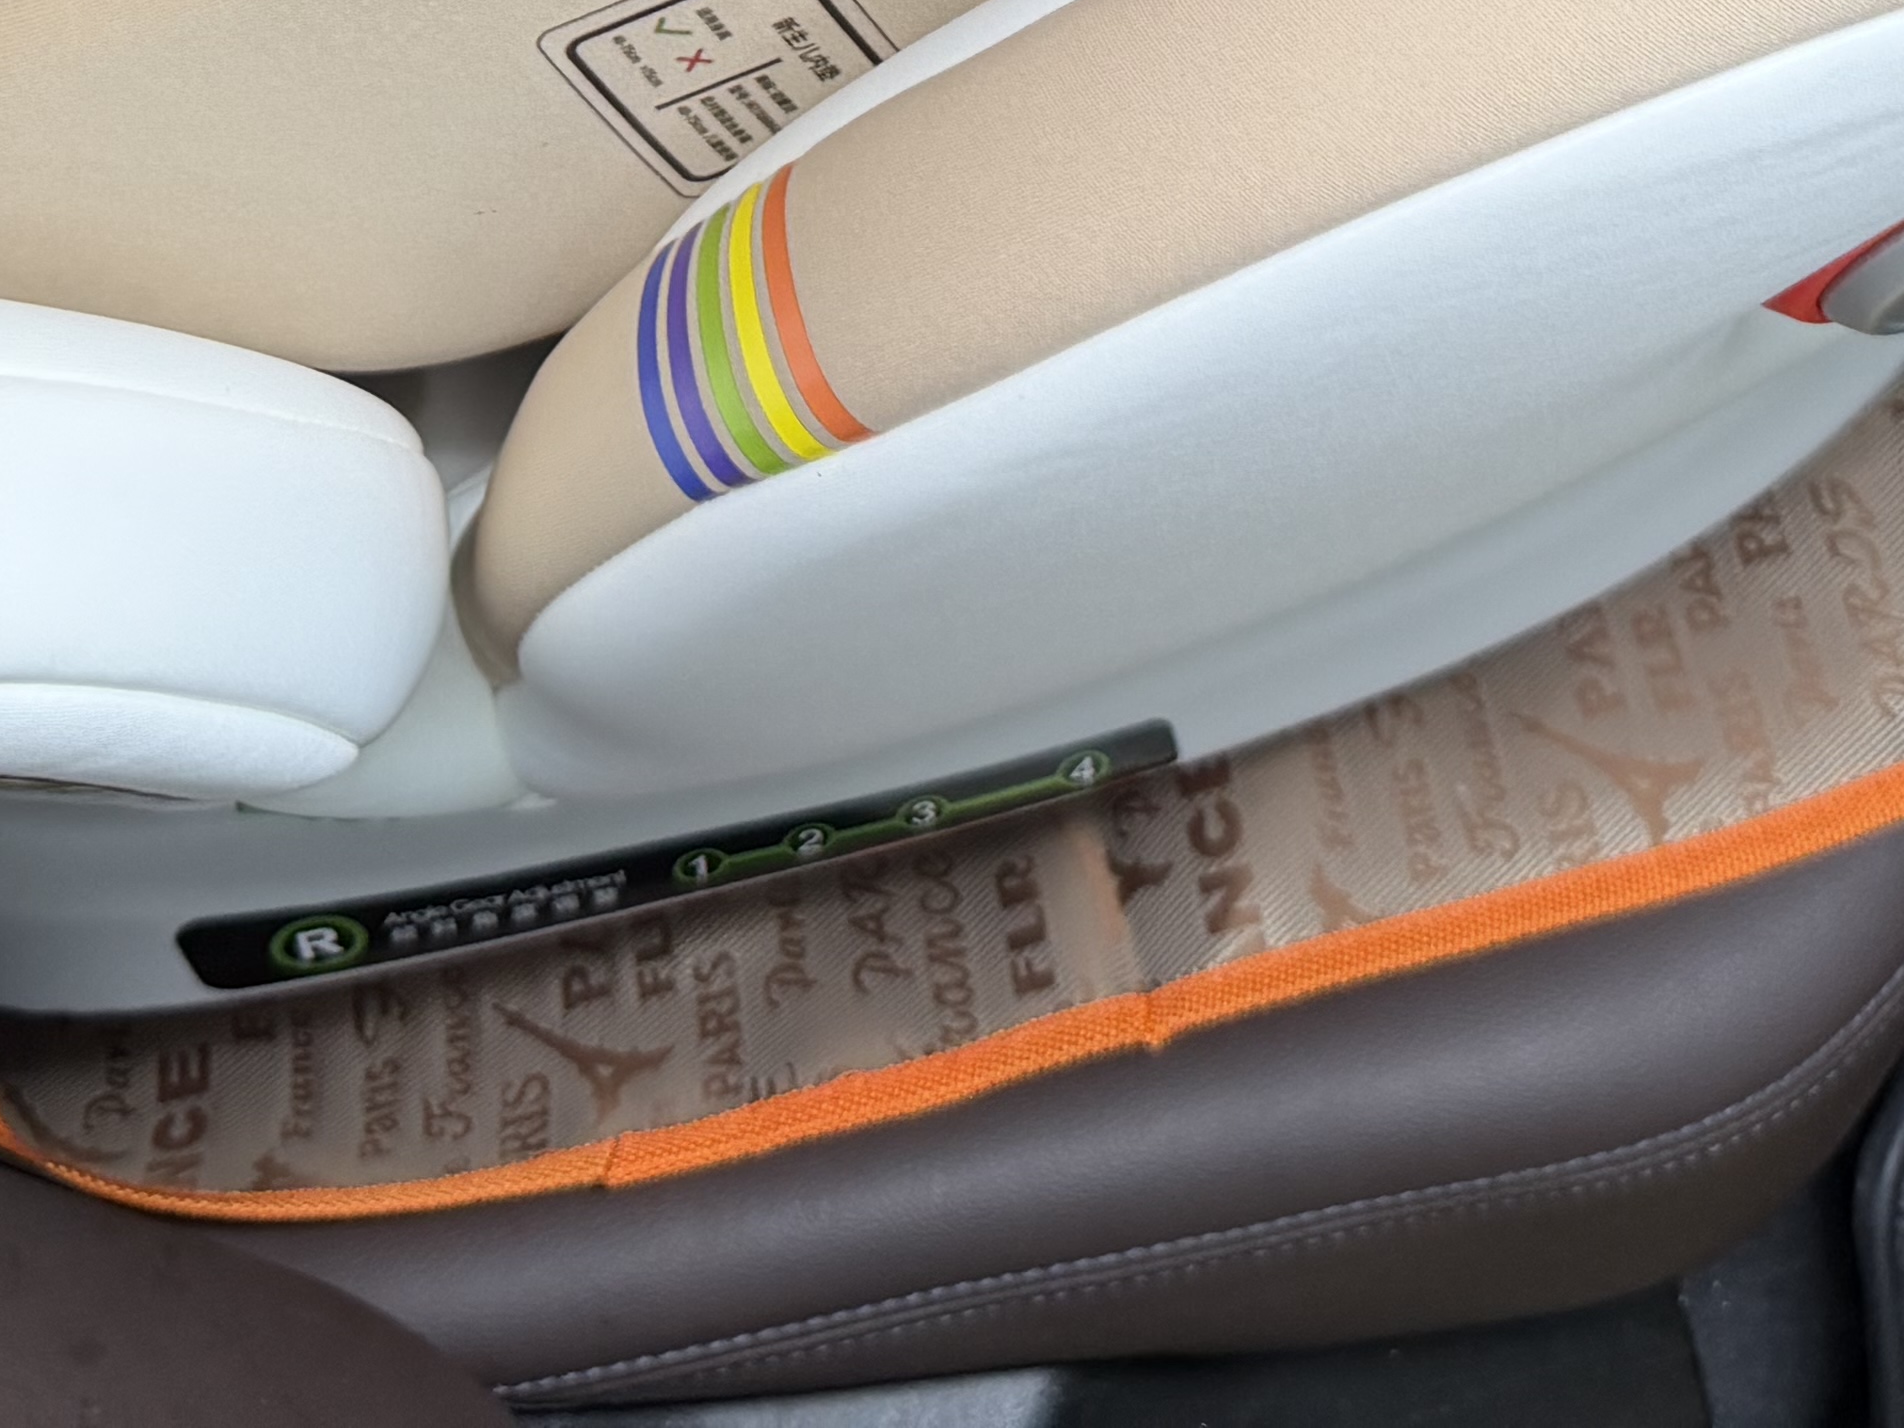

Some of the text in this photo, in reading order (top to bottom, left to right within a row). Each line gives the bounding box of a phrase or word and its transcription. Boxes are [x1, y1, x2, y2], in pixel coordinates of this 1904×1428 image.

[688, 755, 1096, 882] 1 2 3 4
[295, 927, 345, 963] R
[693, 949, 744, 1101] PARIS
